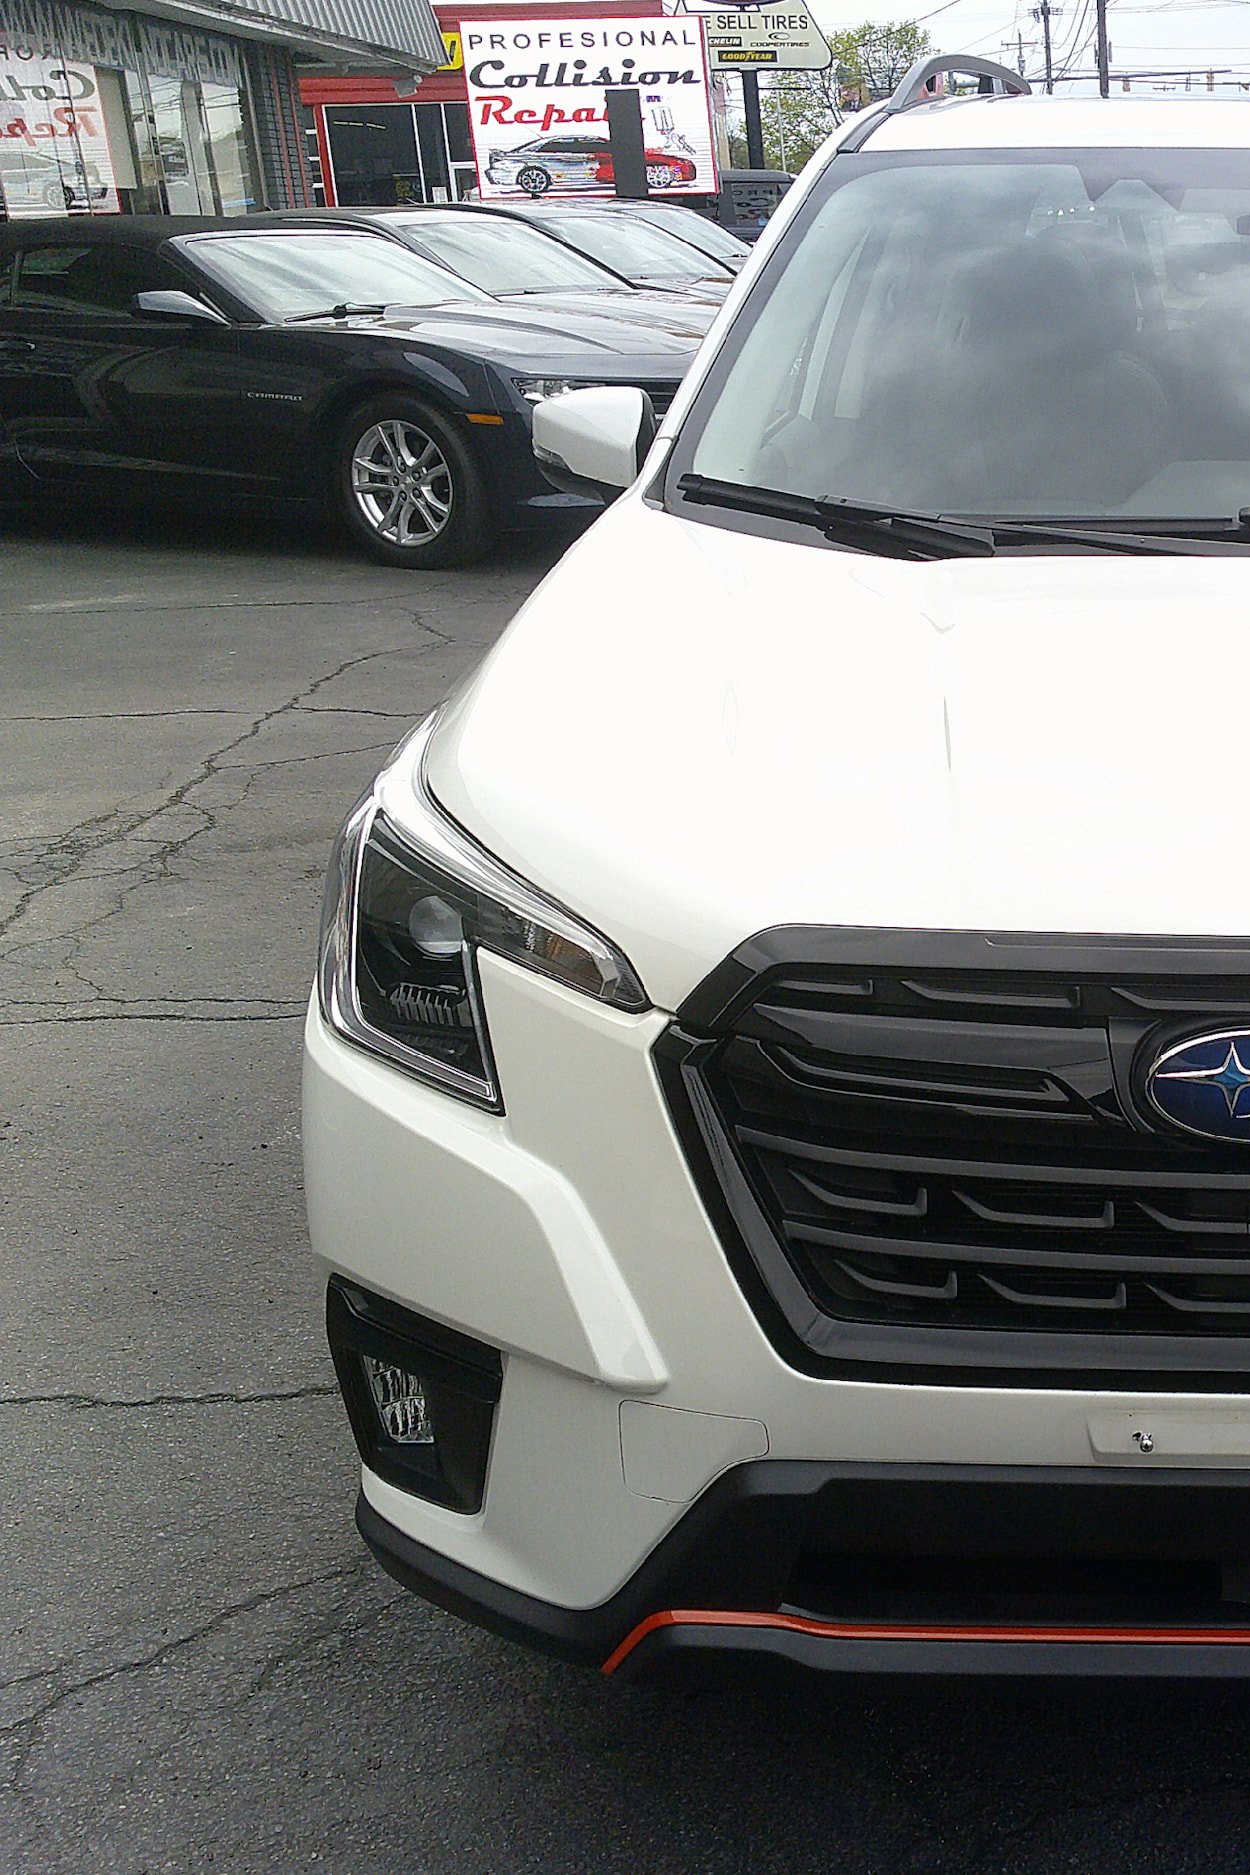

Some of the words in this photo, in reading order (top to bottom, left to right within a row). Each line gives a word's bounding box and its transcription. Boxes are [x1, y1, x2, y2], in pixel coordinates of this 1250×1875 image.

[717, 15, 757, 30] SELL
[761, 15, 808, 30] TIRES
[468, 29, 696, 50] PROFESIONAL
[708, 37, 741, 46] CHELIN
[721, 50, 773, 62] GOODYEAR
[469, 58, 701, 89] Collision
[474, 95, 610, 132] Repa
